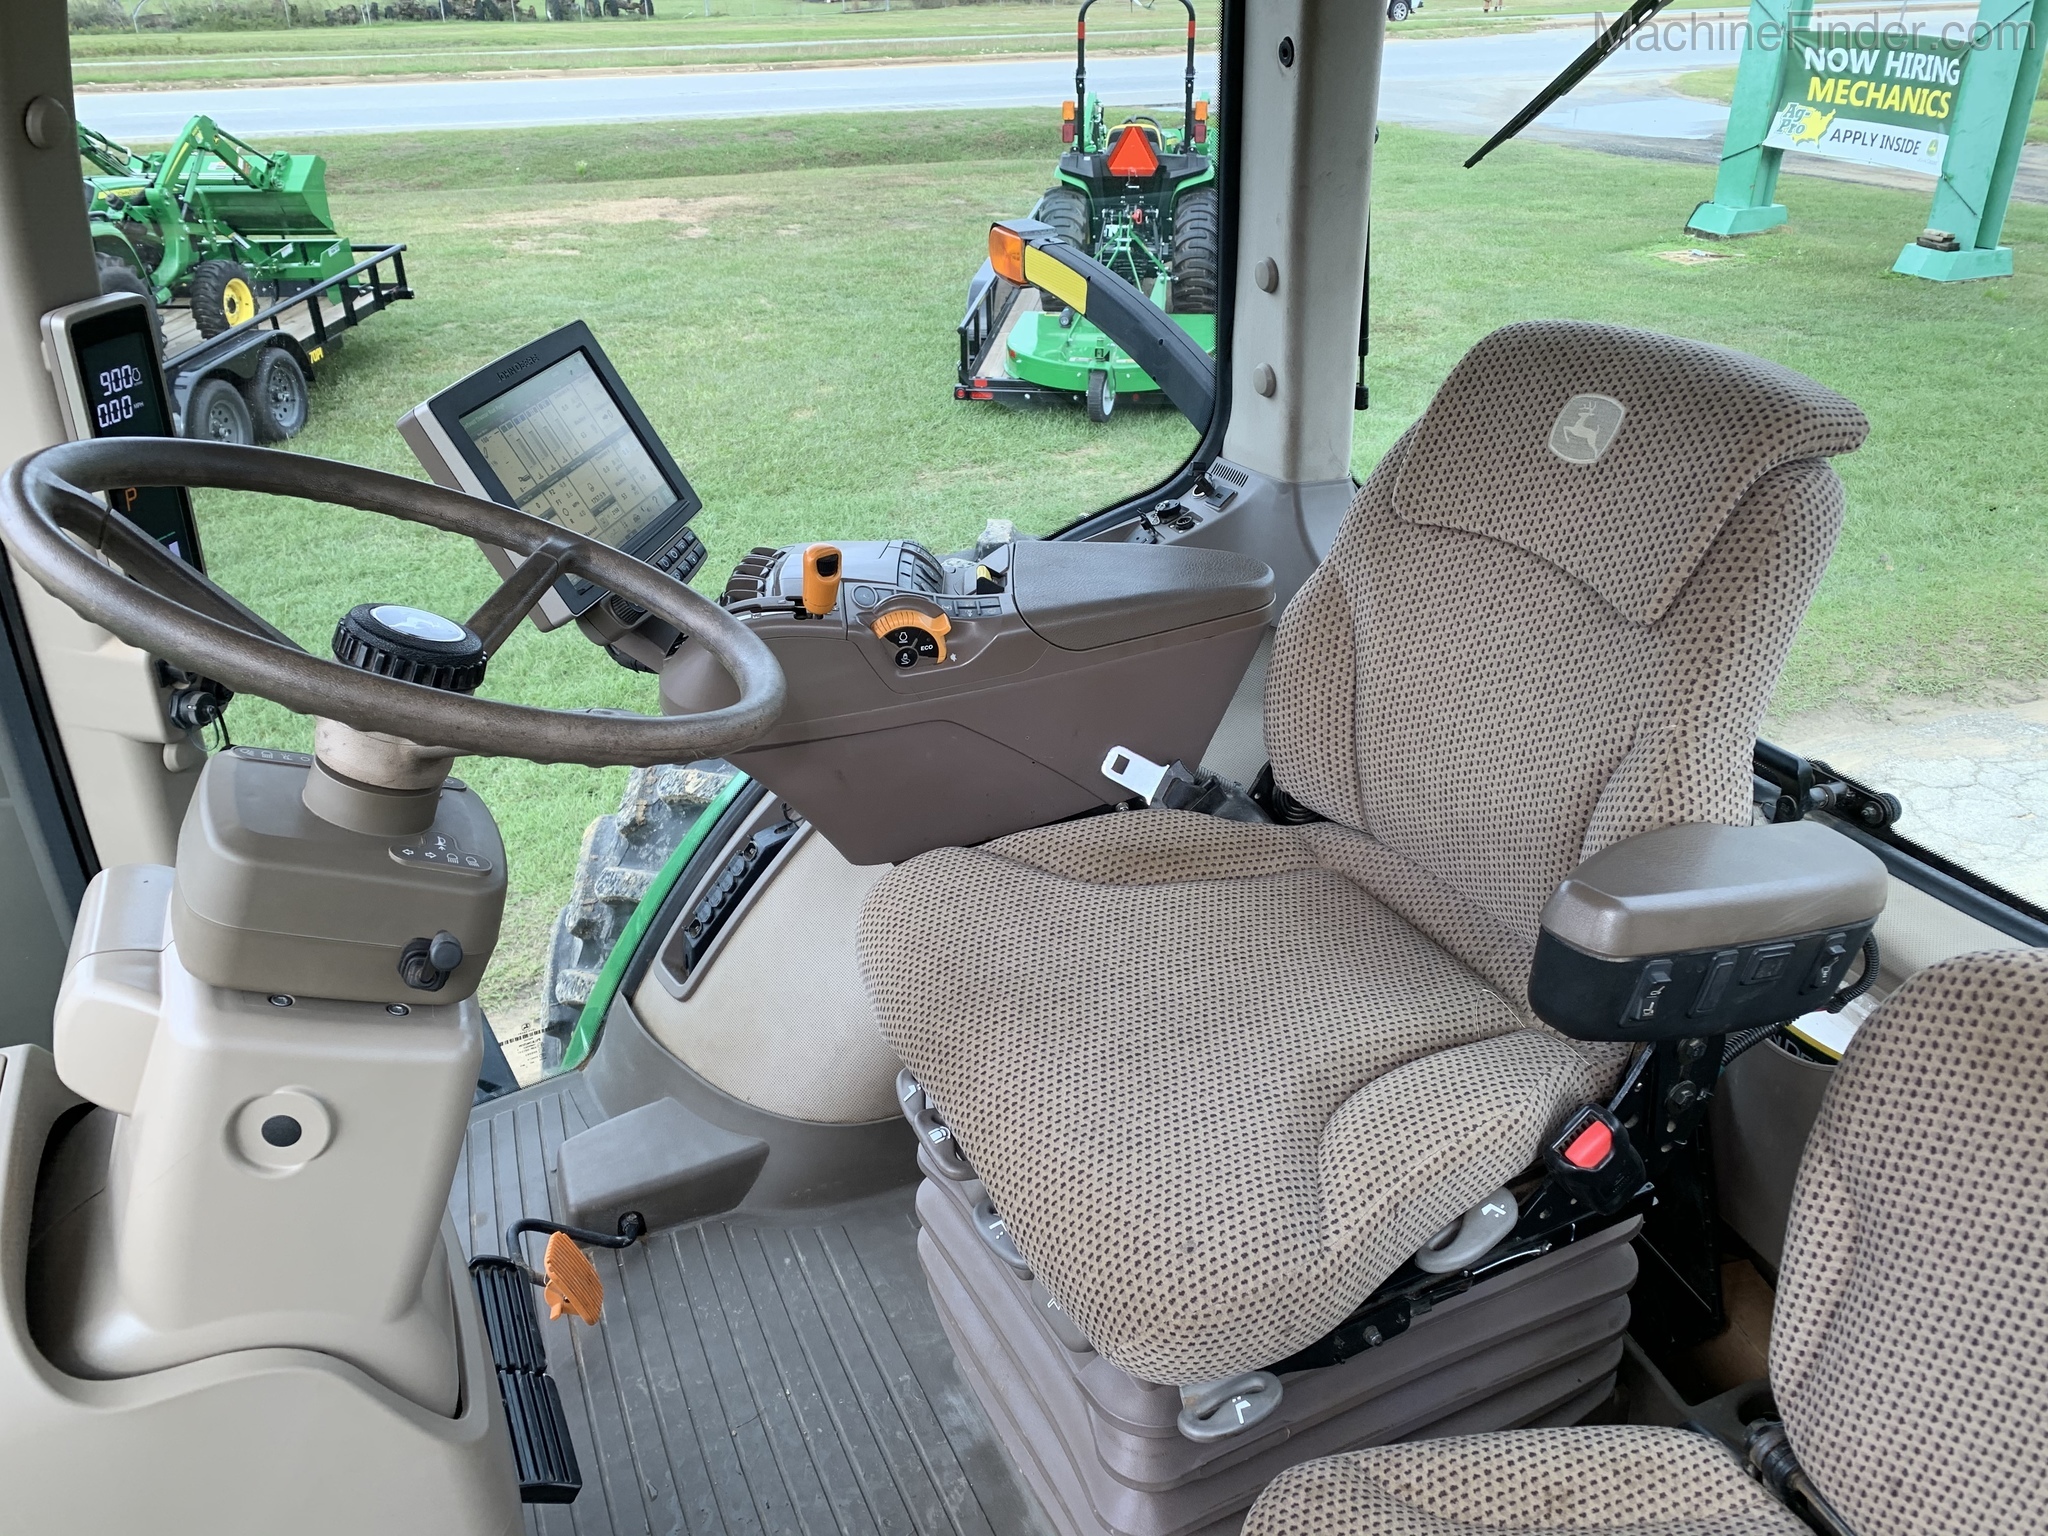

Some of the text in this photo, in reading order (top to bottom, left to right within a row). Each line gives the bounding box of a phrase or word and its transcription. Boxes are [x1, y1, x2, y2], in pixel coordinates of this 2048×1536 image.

[1804, 46, 1961, 86] NOW HIRING
[1807, 76, 1952, 119] MECHANICS
[1782, 102, 1811, 122] Ag-
[1776, 118, 1806, 134] Pro
[1829, 128, 1921, 155] APPLY INSIDE
[100, 364, 133, 396] 900
[97, 394, 133, 428] 0.00
[124, 486, 138, 512] P
[920, 644, 934, 652] ECO
